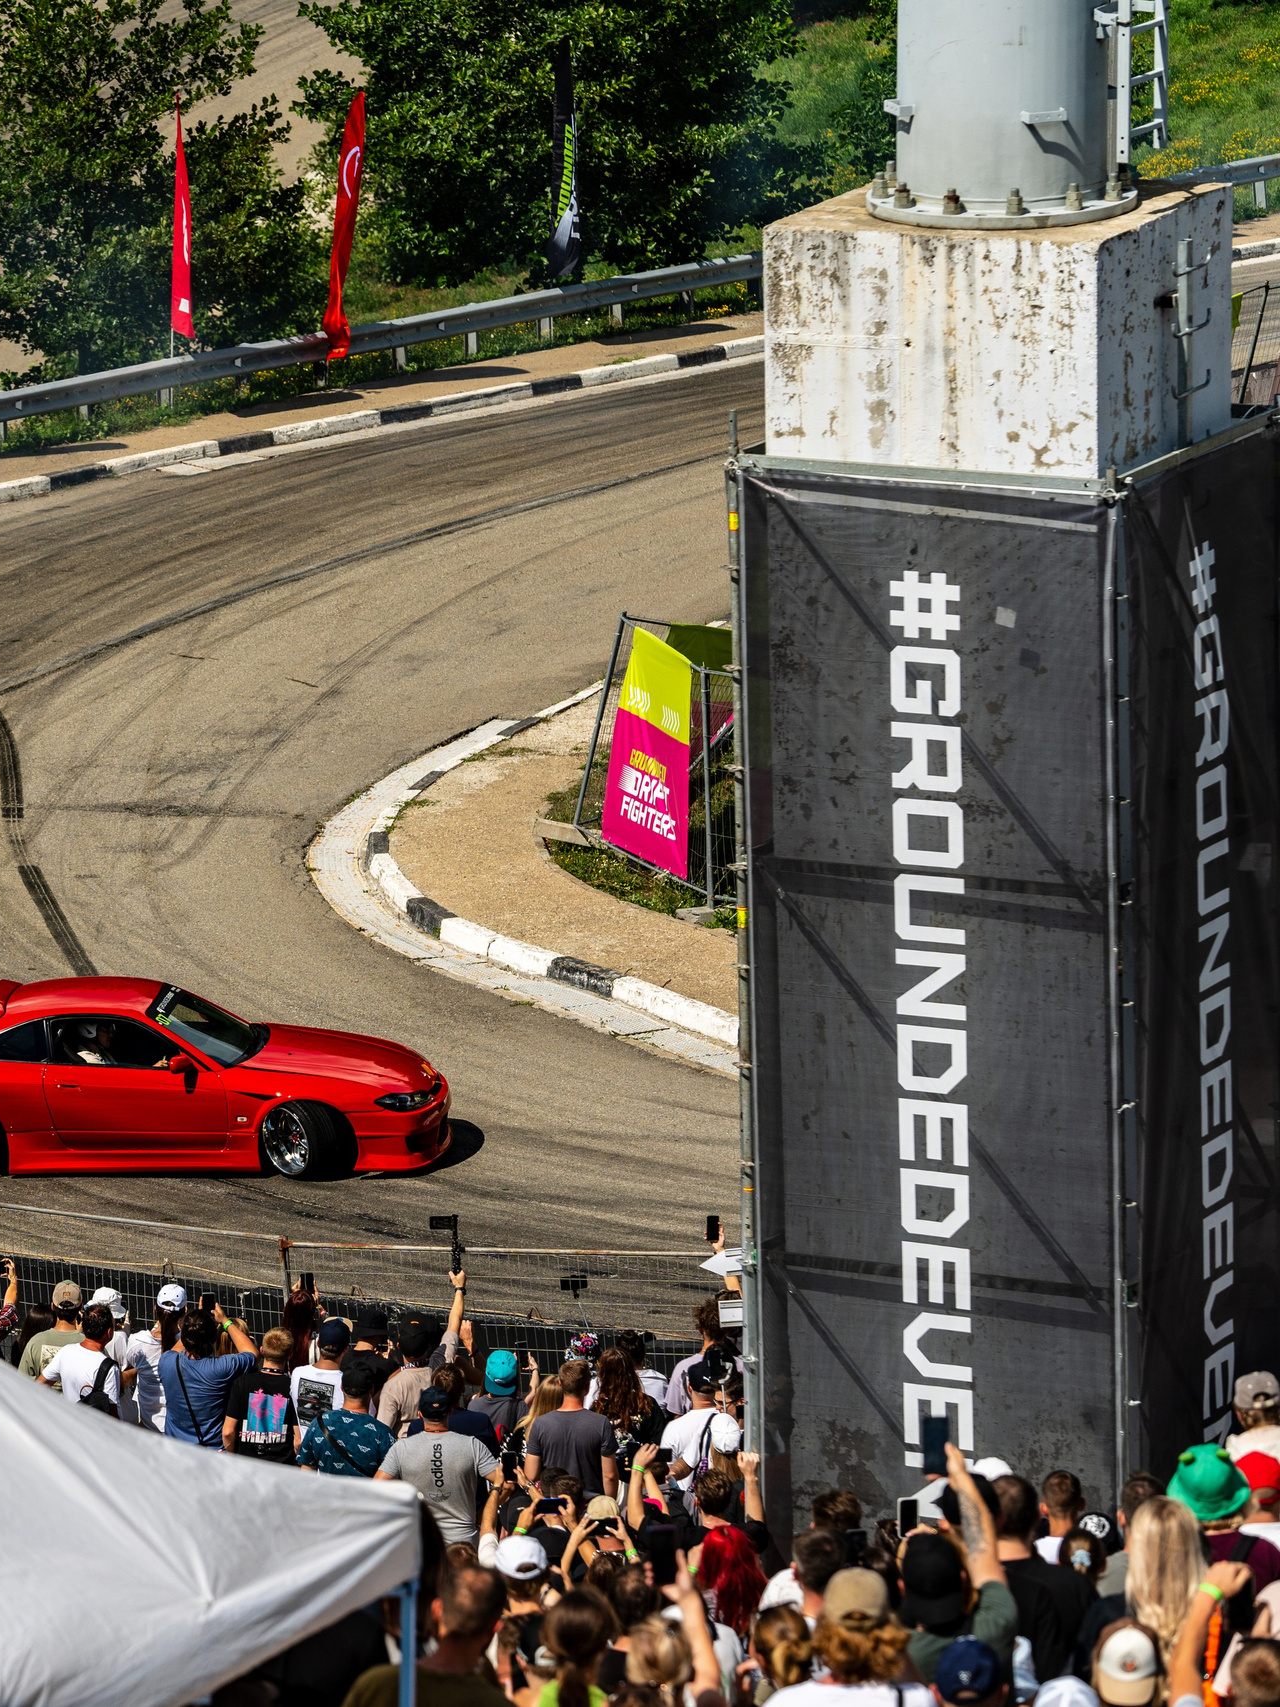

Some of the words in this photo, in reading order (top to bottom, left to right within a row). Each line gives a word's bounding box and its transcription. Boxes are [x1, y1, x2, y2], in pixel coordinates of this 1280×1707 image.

[618, 764, 670, 812] DRIFT
[620, 795, 676, 840] FIGHTERS
[431, 1443, 444, 1488] adidas
